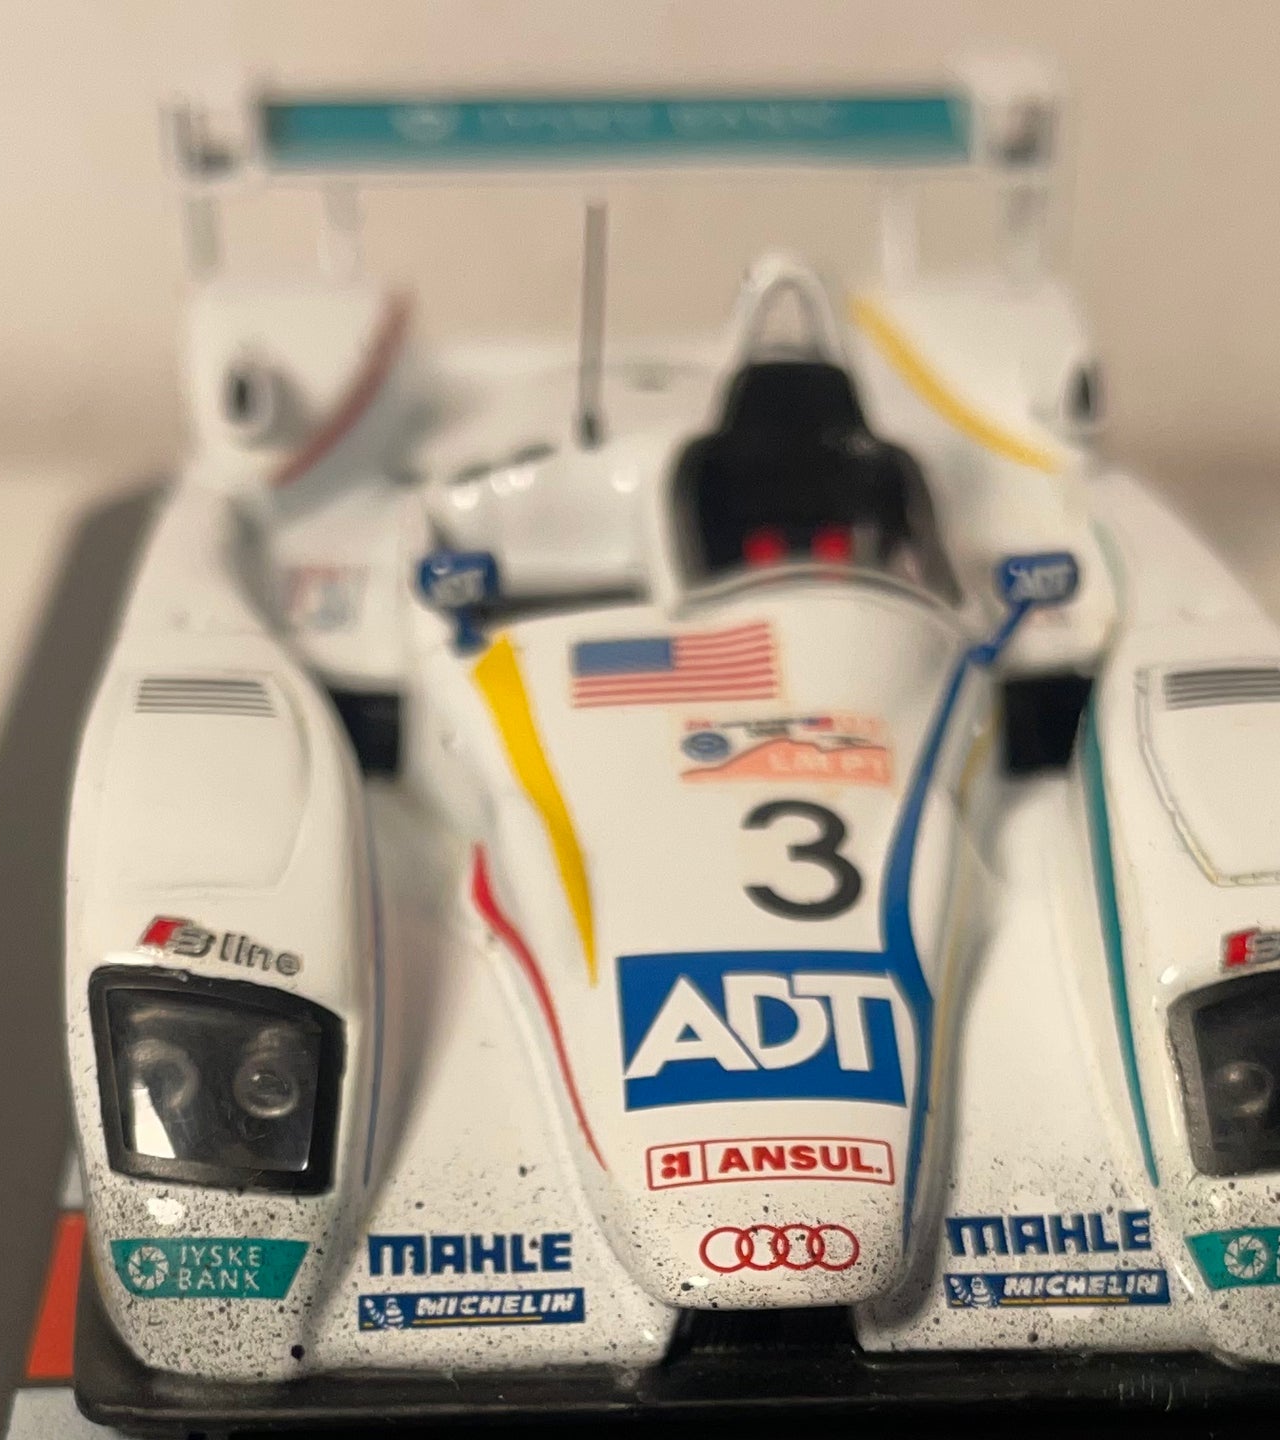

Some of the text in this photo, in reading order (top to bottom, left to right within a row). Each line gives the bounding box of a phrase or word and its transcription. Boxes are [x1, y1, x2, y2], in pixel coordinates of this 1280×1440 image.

[741, 799, 863, 922] 3
[625, 974, 894, 1079] ADT
[369, 1233, 573, 1276] MAHLE
[946, 1211, 1152, 1256] MAHLE
[178, 1267, 261, 1291] BANK
[1003, 1274, 1160, 1296] MICHELIN
[416, 1293, 575, 1318] MICHELIN
